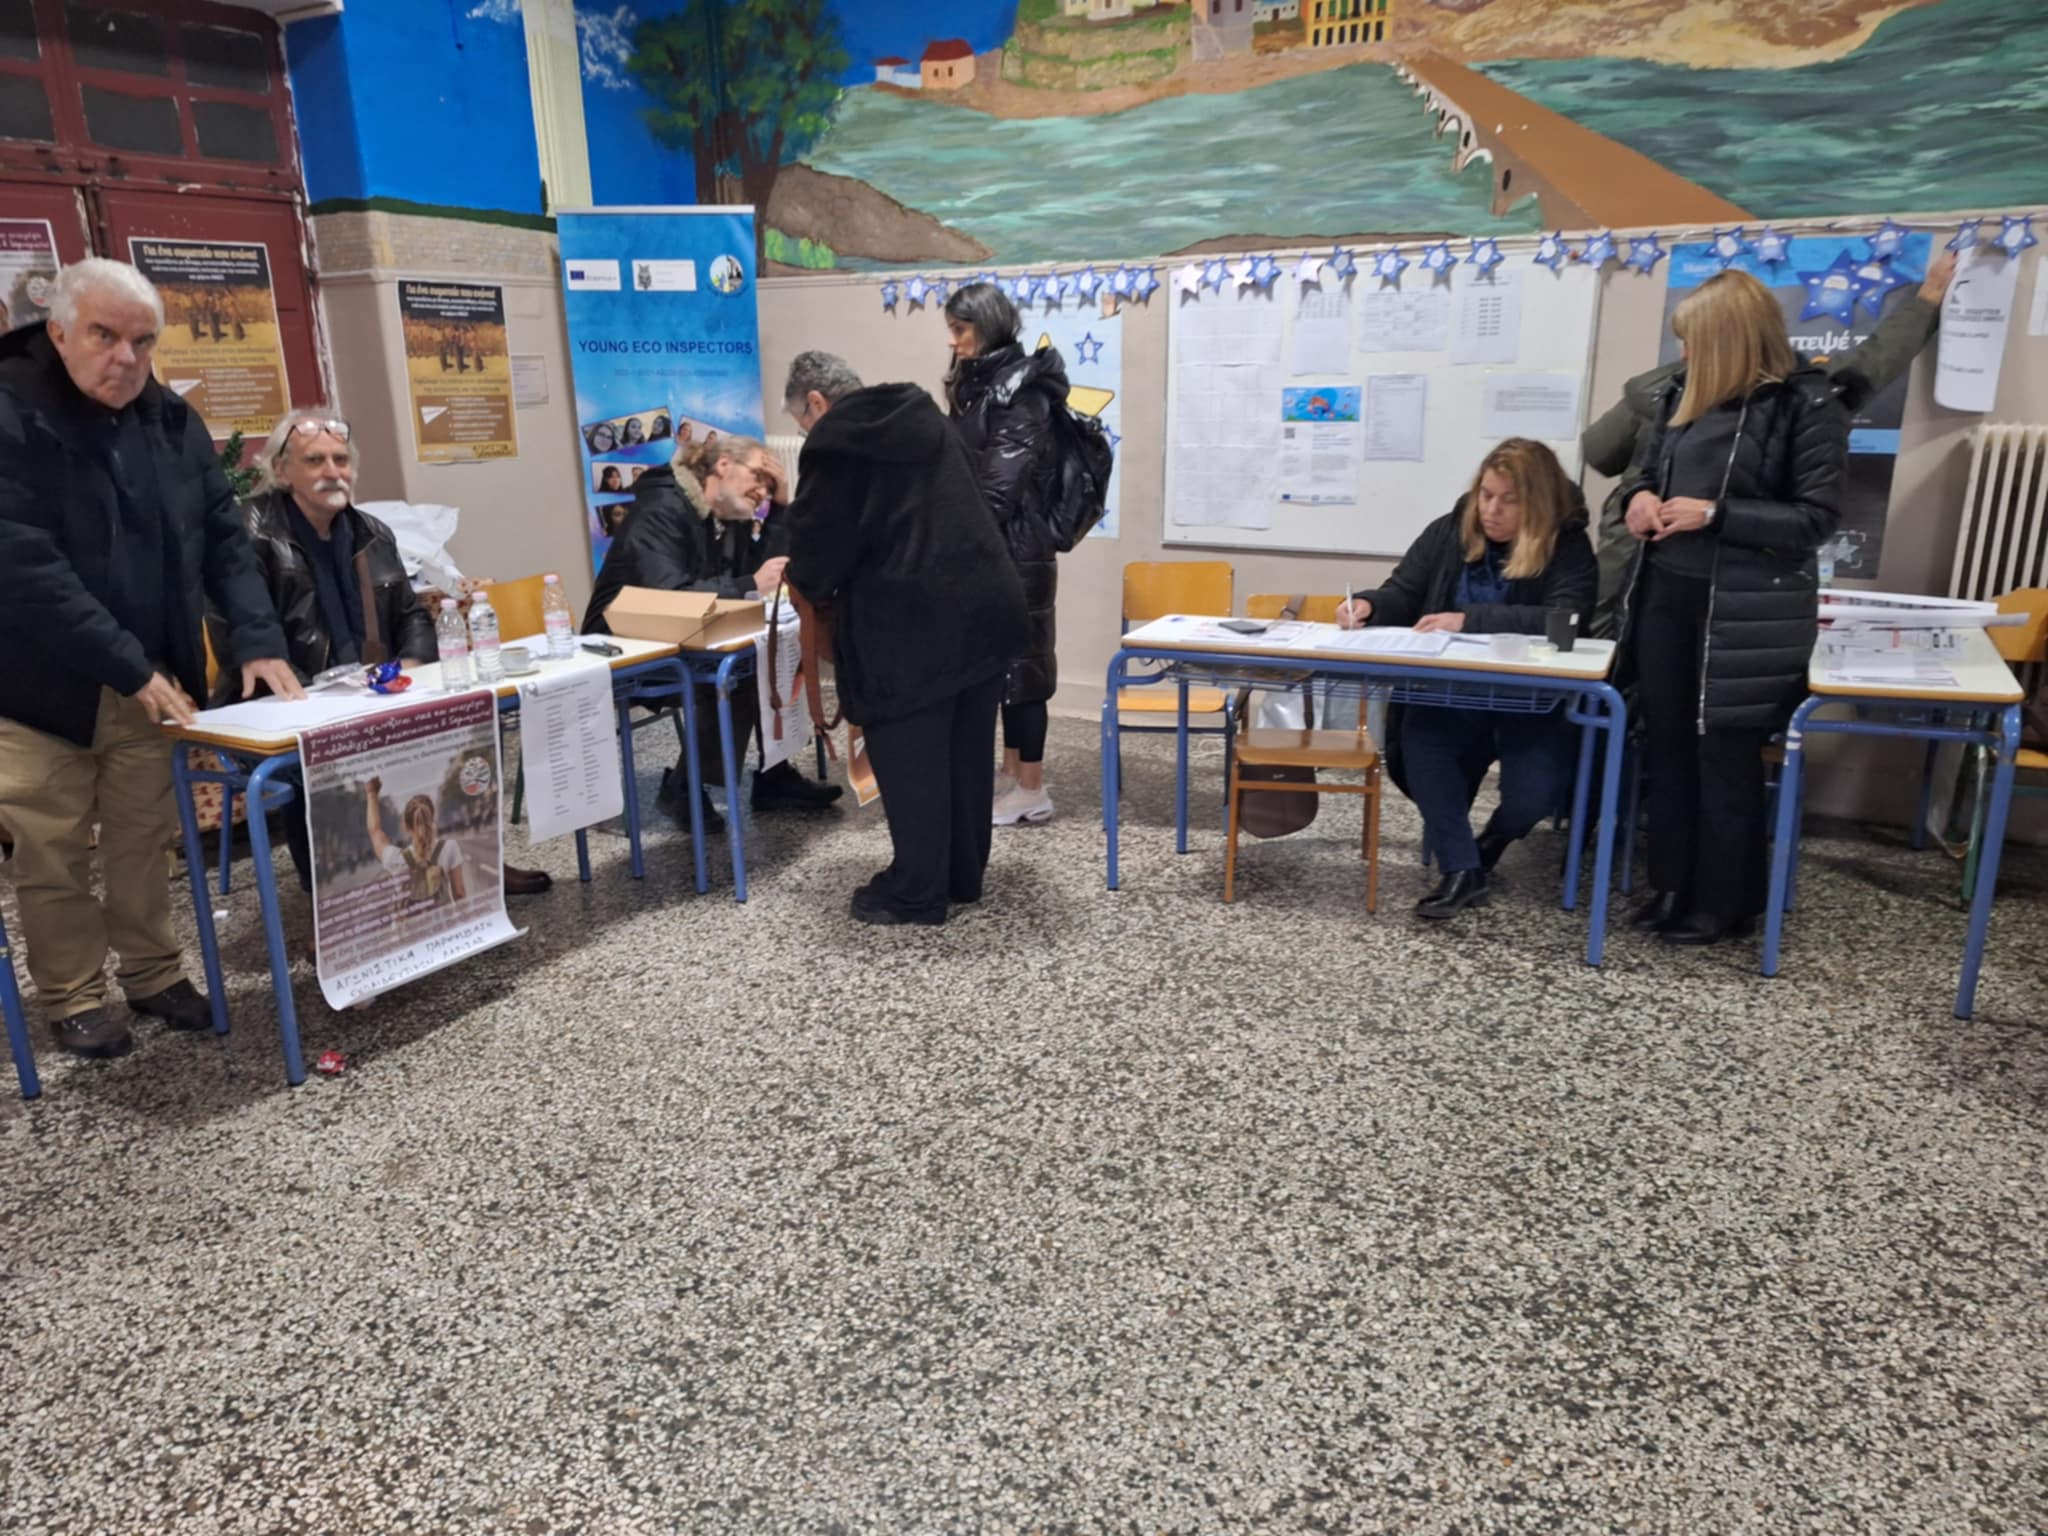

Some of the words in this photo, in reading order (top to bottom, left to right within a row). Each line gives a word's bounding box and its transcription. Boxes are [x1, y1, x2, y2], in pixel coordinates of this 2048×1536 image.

[579, 340, 628, 353] YOUNG
[632, 340, 661, 353] ECO
[666, 341, 752, 354] INSPECTORS
